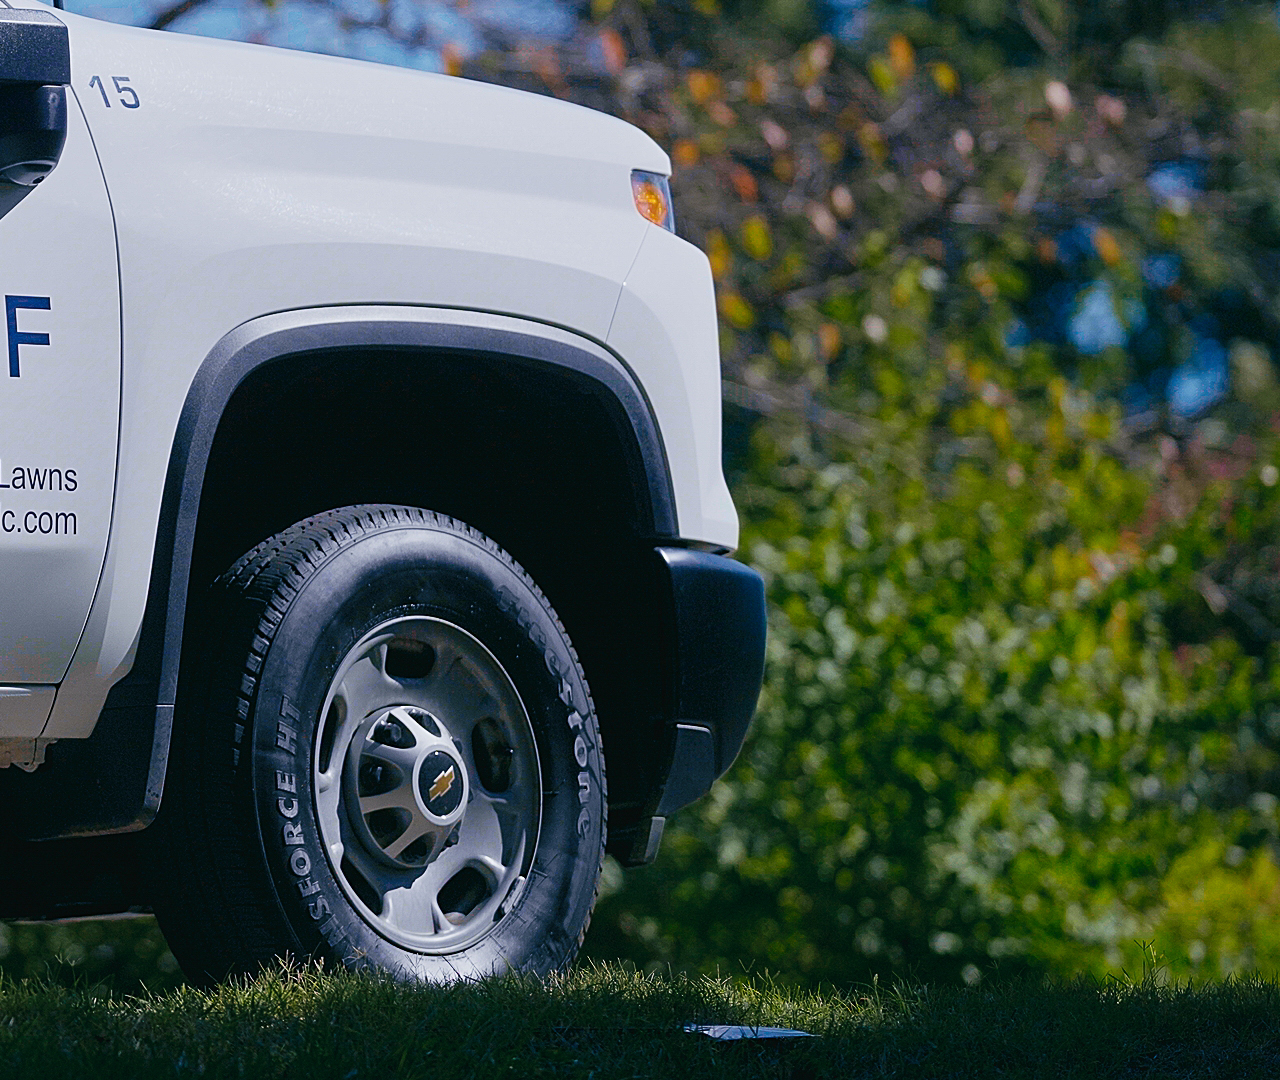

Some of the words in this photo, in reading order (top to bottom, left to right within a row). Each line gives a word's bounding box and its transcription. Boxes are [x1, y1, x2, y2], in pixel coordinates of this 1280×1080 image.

[89, 76, 140, 109] 15
[275, 694, 301, 756] HT
[496, 584, 590, 840] Firestone
[276, 770, 347, 948] NSFORCE
